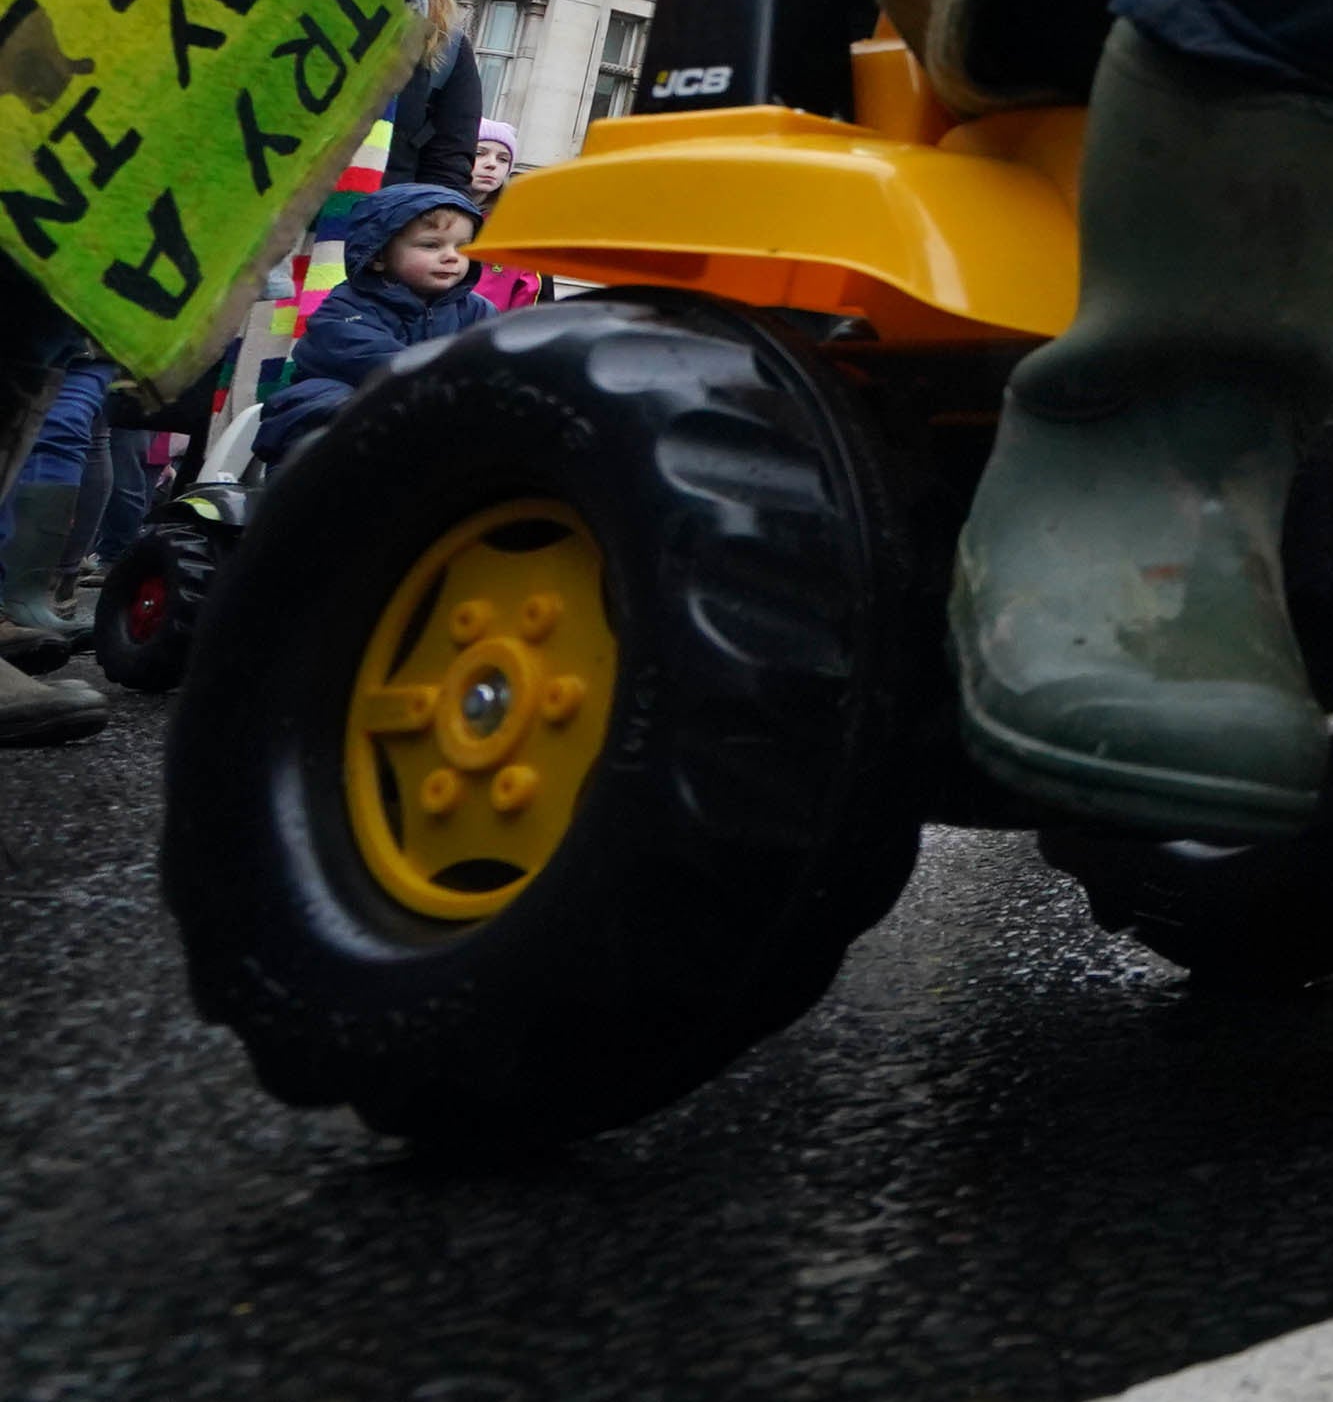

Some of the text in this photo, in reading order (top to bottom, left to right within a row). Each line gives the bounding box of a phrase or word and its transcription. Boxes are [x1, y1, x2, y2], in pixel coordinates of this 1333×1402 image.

[652, 66, 733, 98] JCB
[0, 86, 143, 260] IN
[103, 187, 203, 320] A
